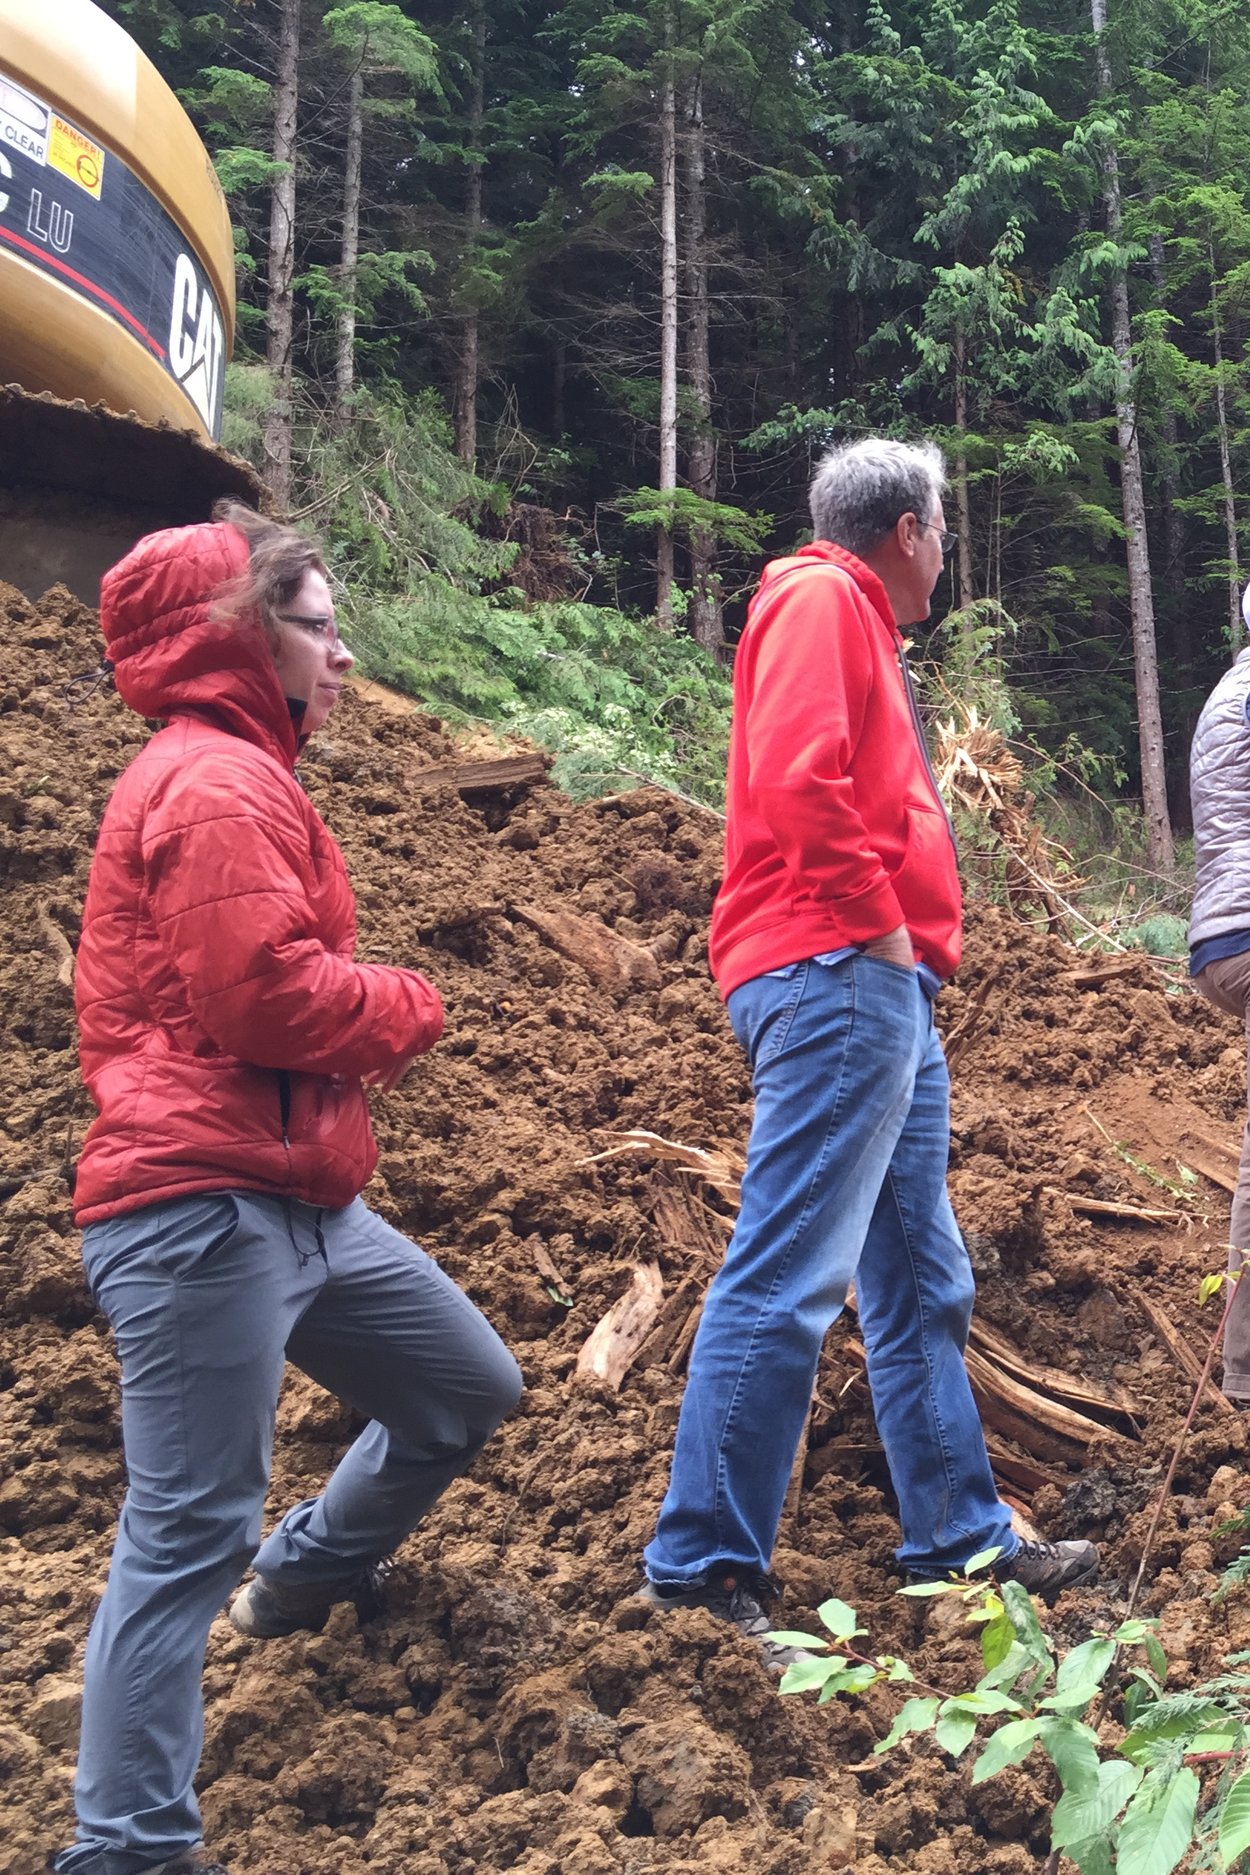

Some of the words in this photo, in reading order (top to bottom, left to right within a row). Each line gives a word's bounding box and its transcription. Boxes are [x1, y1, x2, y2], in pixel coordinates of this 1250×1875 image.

[5, 125, 44, 159] CLEAR
[27, 188, 74, 253] LU
[169, 253, 223, 437] CAT
